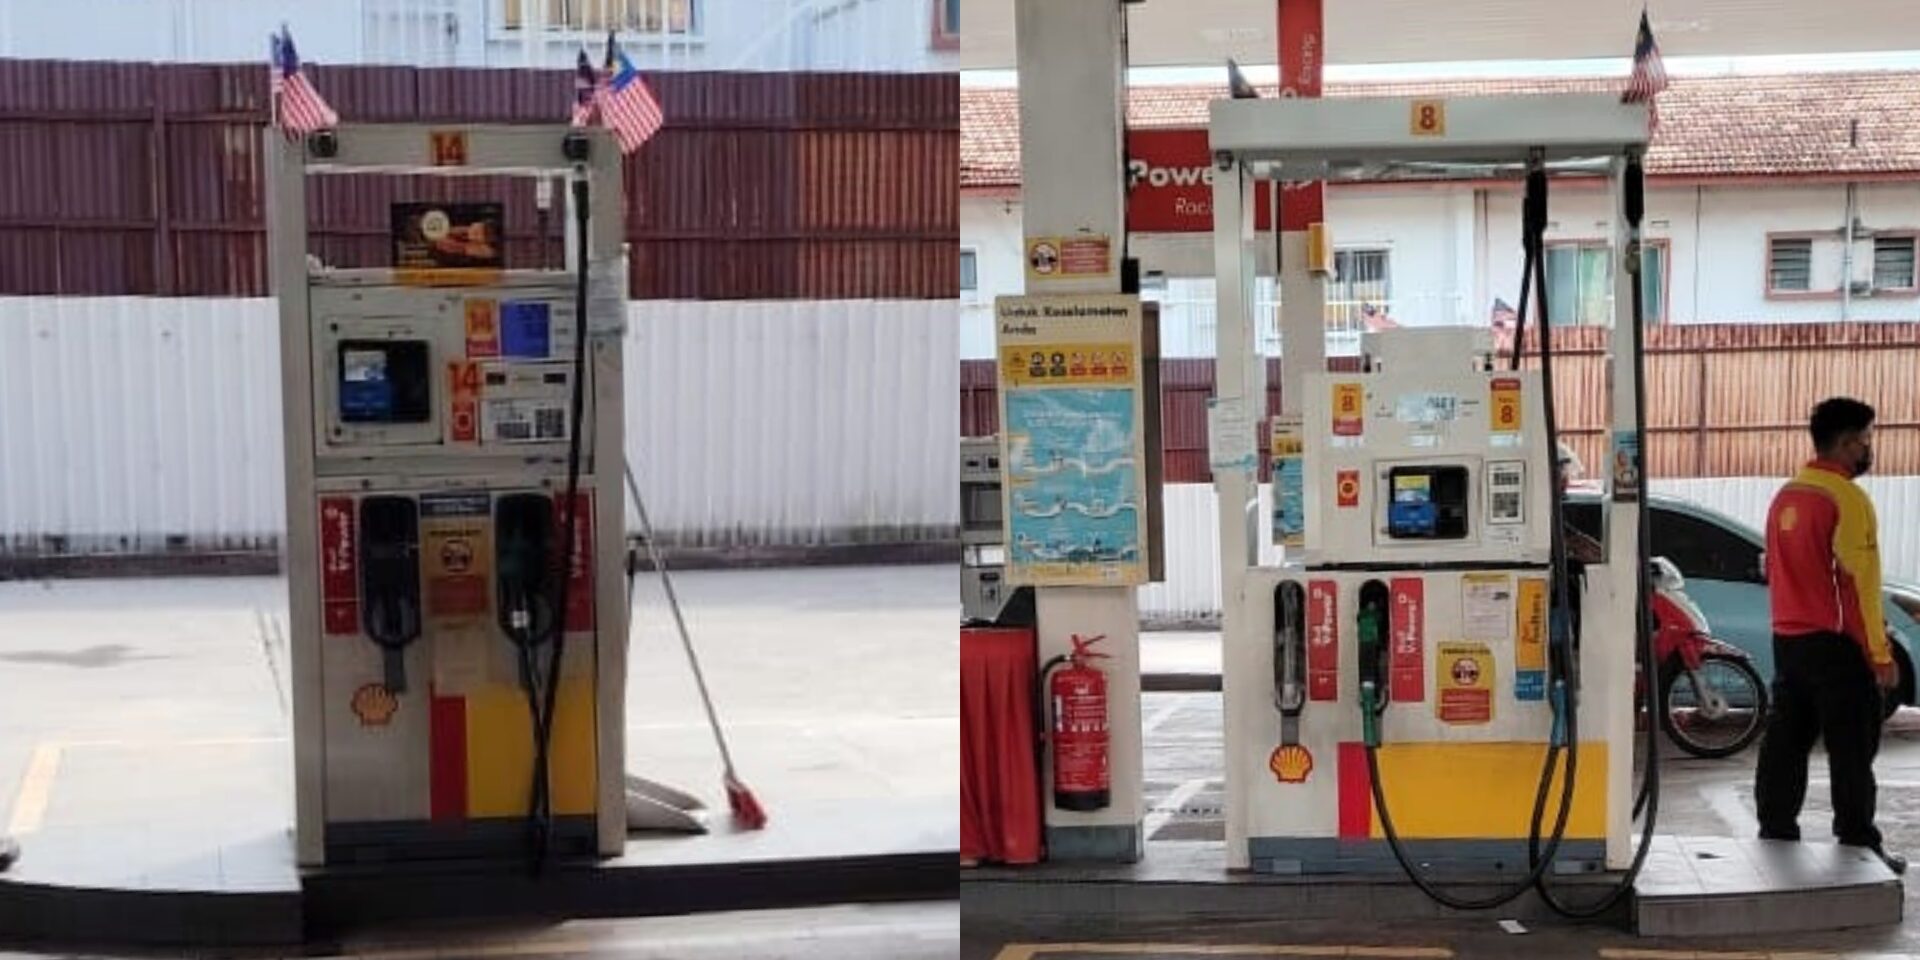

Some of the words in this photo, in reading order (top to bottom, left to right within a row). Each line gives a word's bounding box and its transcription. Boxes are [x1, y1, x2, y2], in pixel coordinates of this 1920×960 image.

[1420, 105, 1436, 130] 8
[432, 132, 466, 167] 14
[1129, 160, 1213, 191] Powe
[1175, 197, 1212, 216] Rac
[448, 361, 483, 398] 14
[1501, 404, 1513, 424] 8
